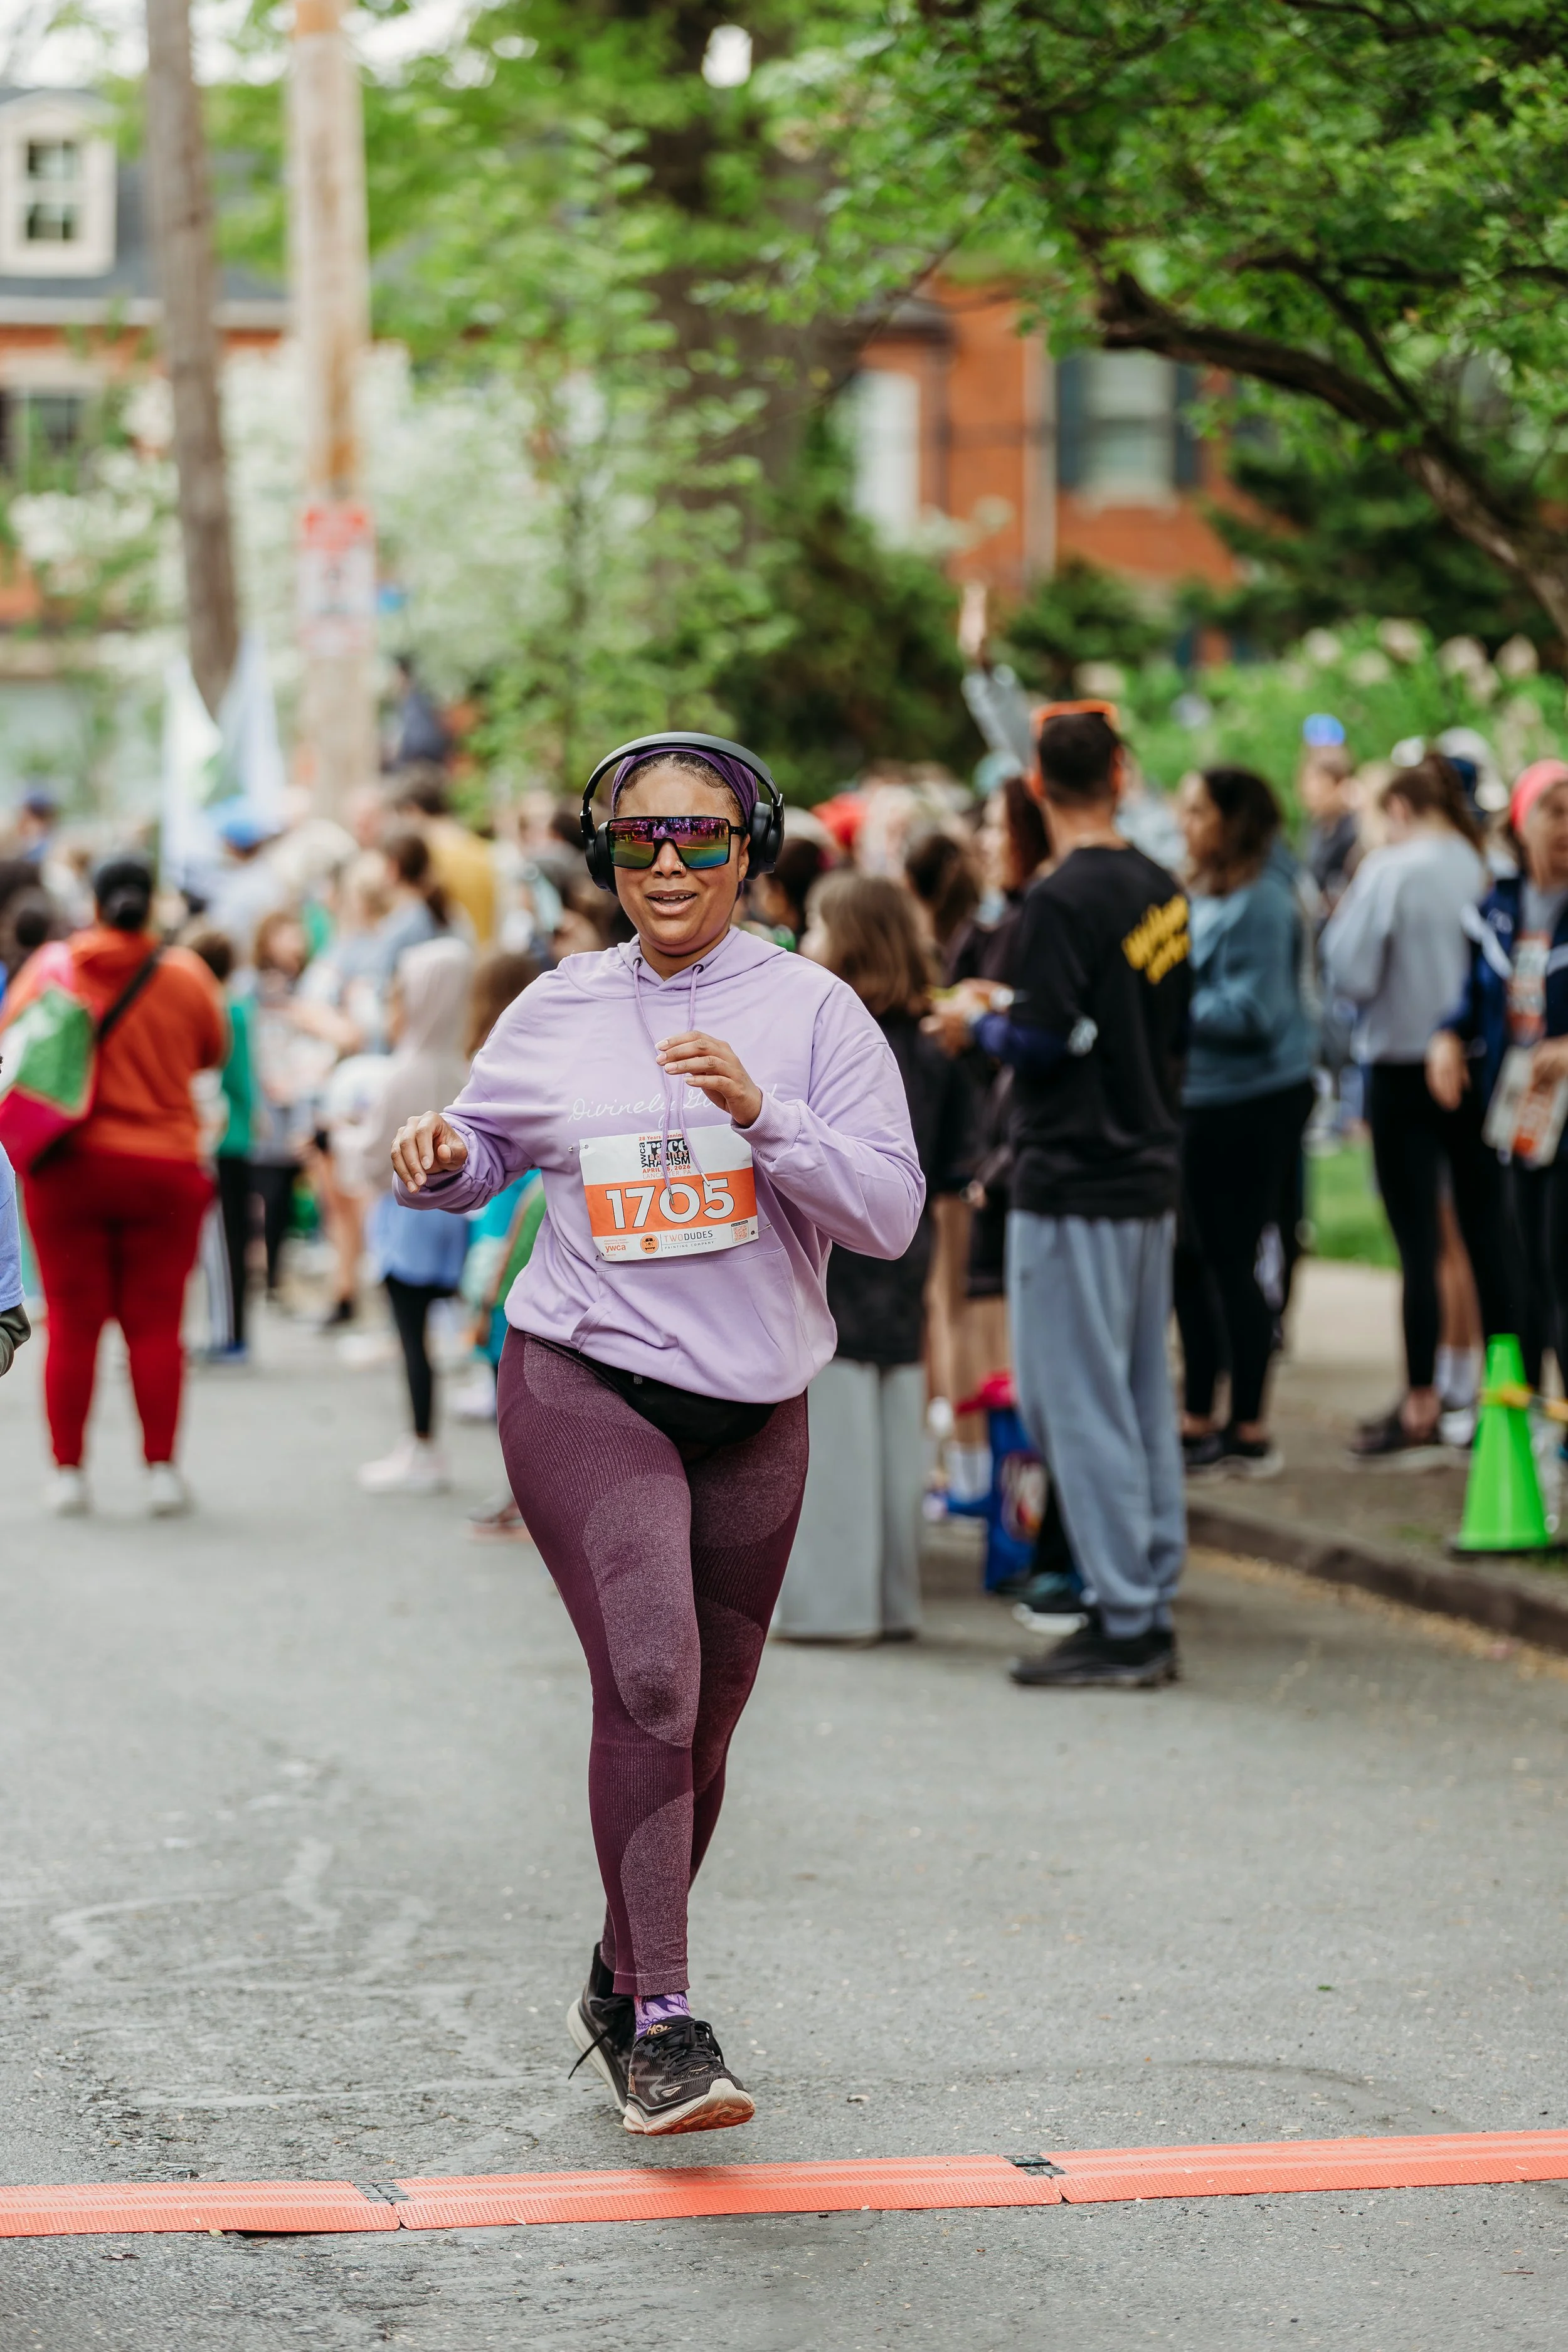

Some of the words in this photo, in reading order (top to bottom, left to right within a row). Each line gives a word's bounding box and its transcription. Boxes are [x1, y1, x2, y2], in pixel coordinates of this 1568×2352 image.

[640, 1142, 649, 1168] ywca
[649, 1151, 688, 1162] aginst
[643, 1170, 681, 1179] LANCATER,
[605, 1178, 734, 1229] 1705
[605, 1244, 626, 1253] ywca
